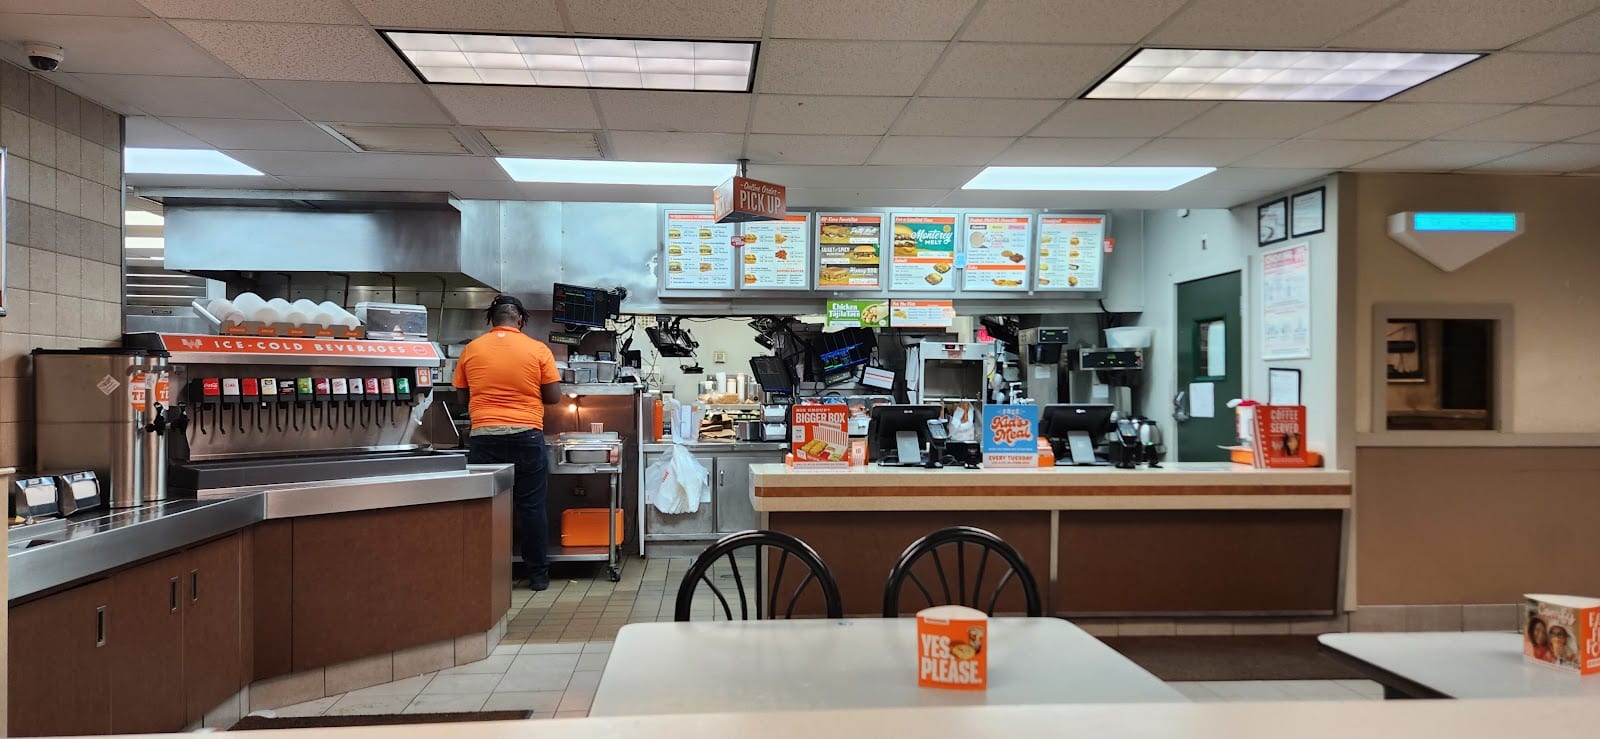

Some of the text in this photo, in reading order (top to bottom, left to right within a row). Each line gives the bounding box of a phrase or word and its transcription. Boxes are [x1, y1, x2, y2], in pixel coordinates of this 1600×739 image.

[743, 181, 778, 196] Online Order
[739, 189, 765, 212] PICK
[767, 195, 781, 214] UP
[911, 229, 954, 244] Monterey
[832, 303, 857, 311] Chicken
[214, 341, 406, 354] ICE-COLD BEVERAGES
[795, 412, 846, 424] BIGGER BOX
[1271, 410, 1299, 420] COFFEE
[1271, 422, 1299, 433] SERVED
[993, 428, 1032, 444] Meal
[920, 656, 983, 684] PLEASE.
